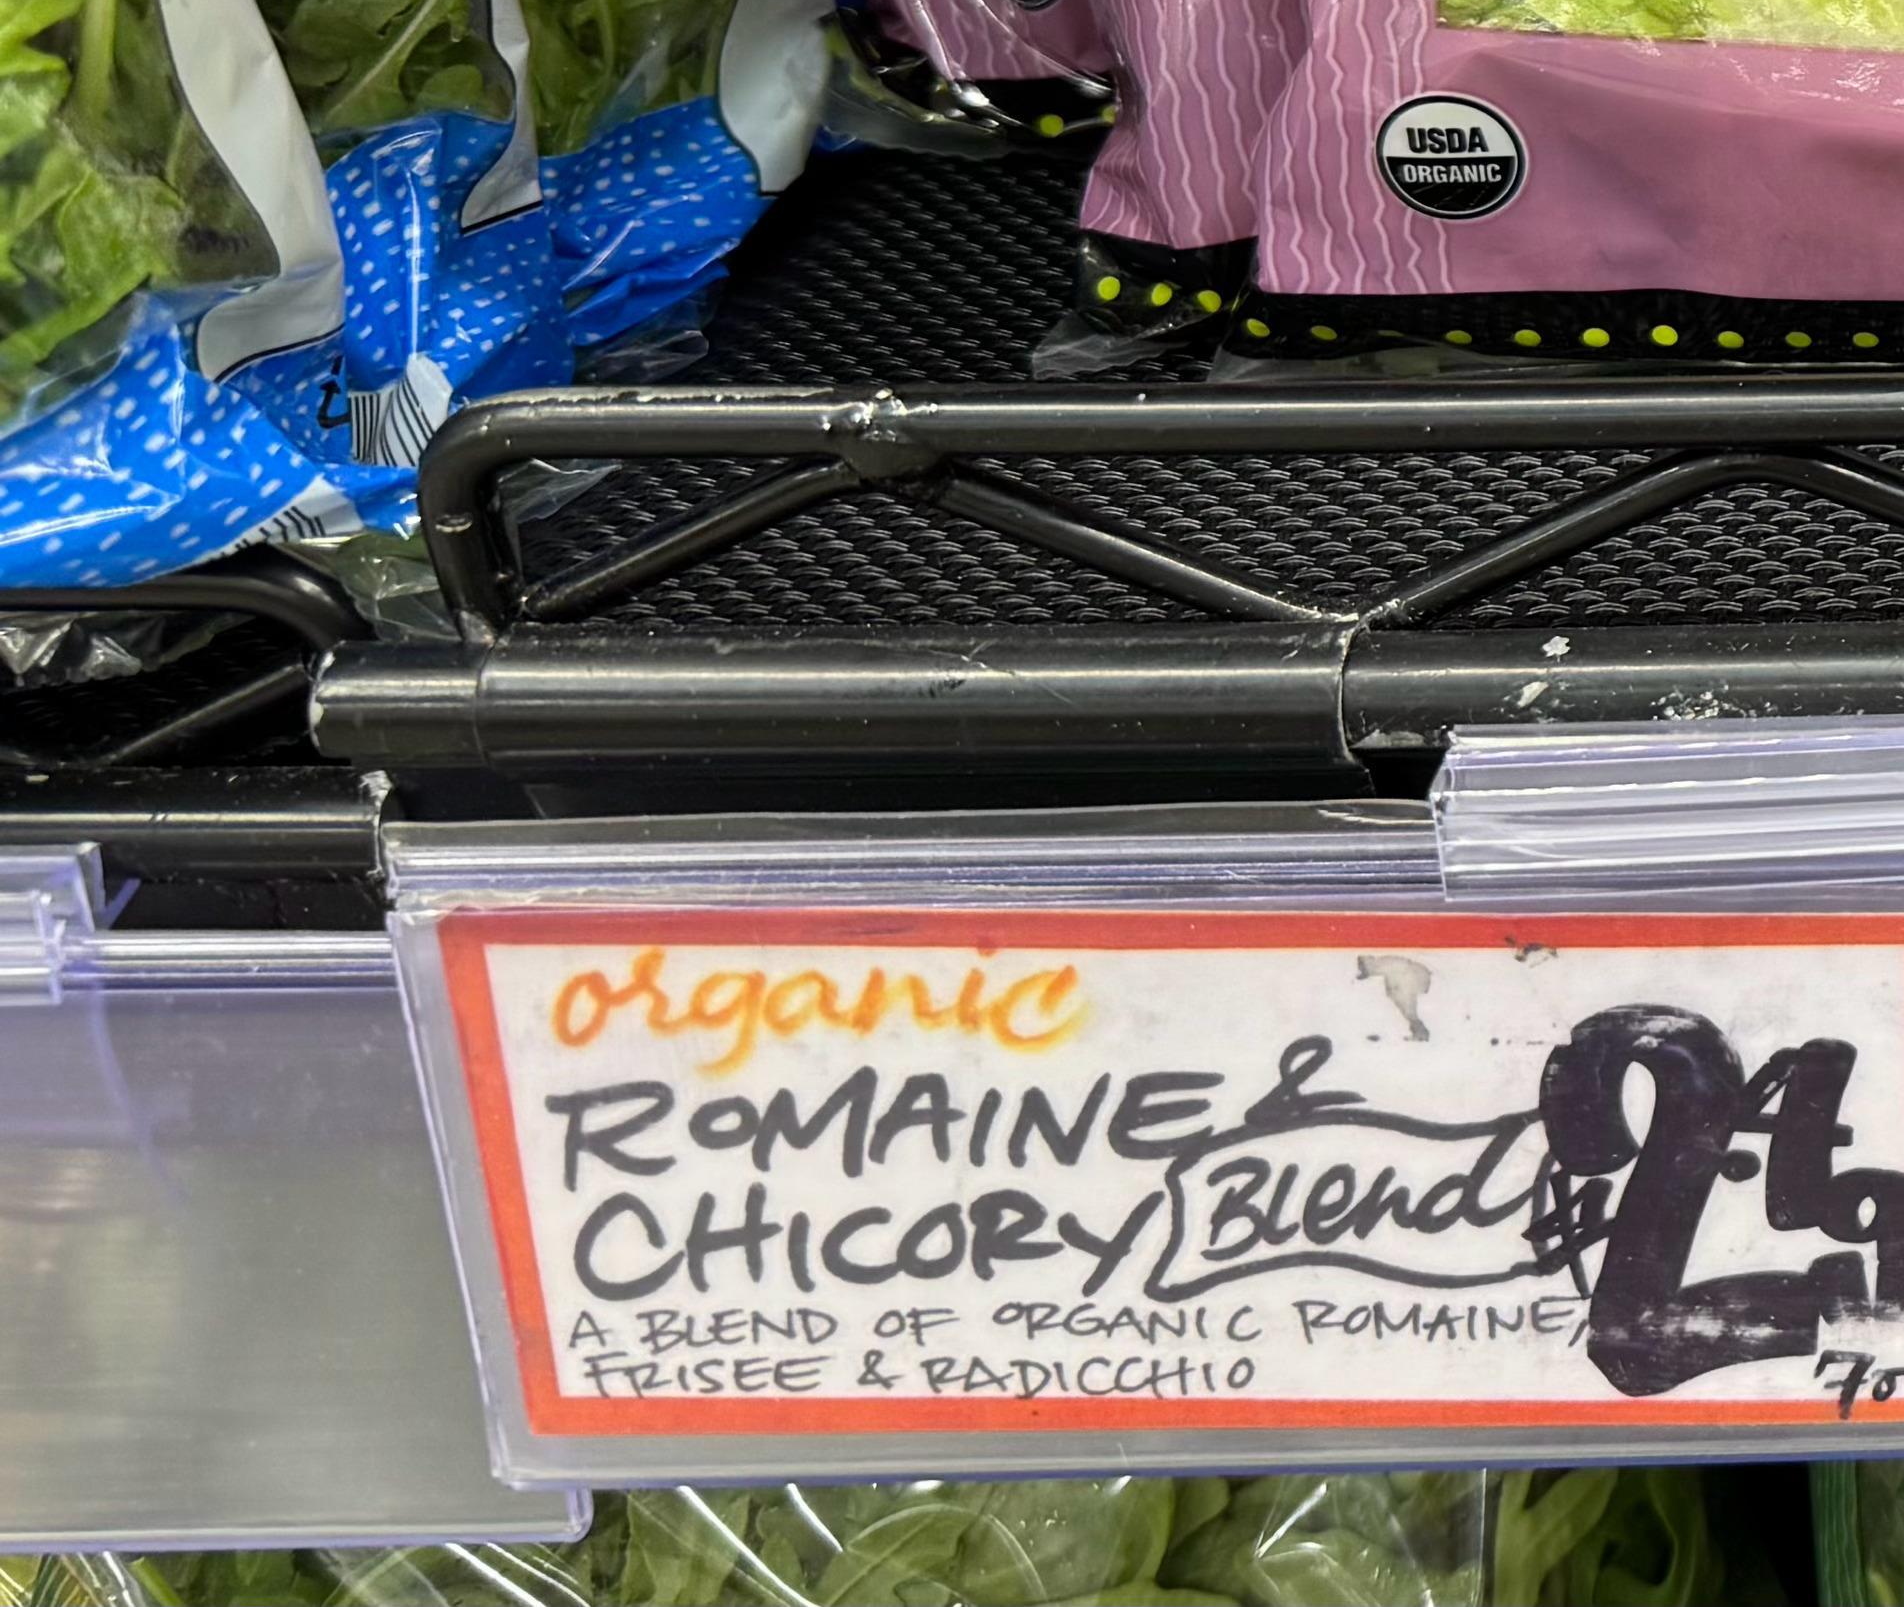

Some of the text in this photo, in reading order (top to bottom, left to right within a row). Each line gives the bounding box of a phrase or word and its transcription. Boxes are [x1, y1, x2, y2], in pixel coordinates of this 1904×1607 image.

[1406, 127, 1489, 154] USDA
[1402, 163, 1502, 183] ORGANIC
[551, 948, 1086, 1078] organic
[546, 1034, 1366, 1192] ROMAINE &
[572, 1122, 1535, 1302] CHICORY Blend
[569, 1295, 1595, 1350] A BLEND OF ORGANIC ROMAINE,
[583, 1350, 1258, 1401] FRISEE & RADICCHIO
